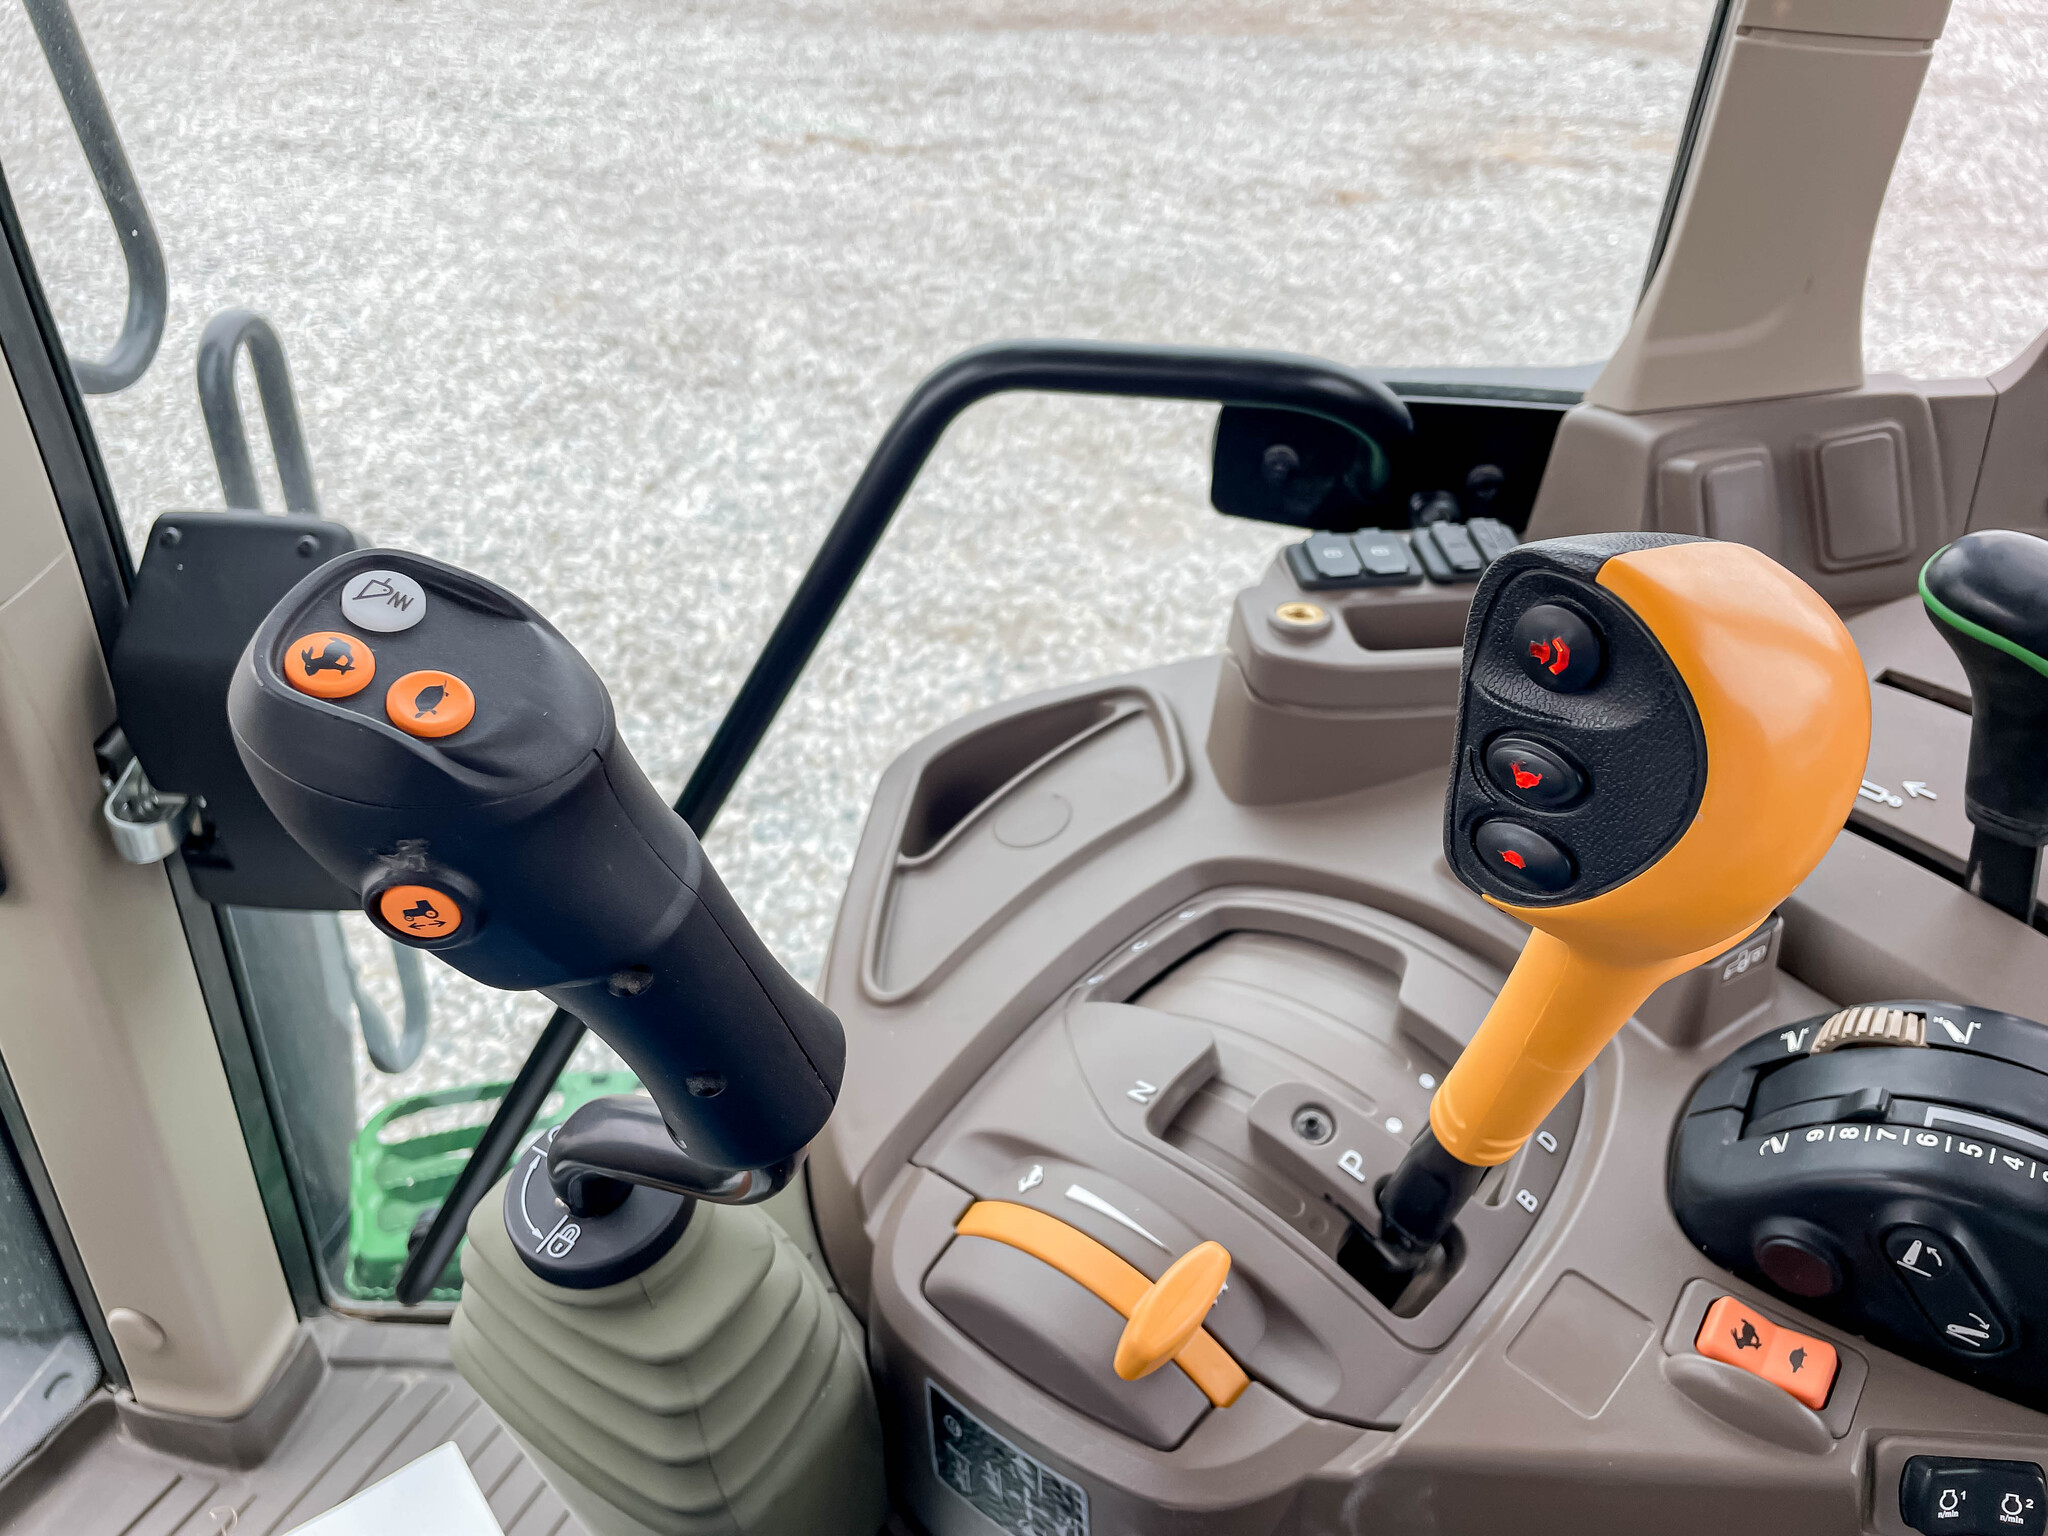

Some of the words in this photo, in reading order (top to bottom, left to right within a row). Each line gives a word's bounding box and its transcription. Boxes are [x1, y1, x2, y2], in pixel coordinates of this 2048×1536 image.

[1127, 1080, 1157, 1104] N
[1536, 1130, 1558, 1153] D
[1806, 1128, 1825, 1142] 9
[1839, 1127, 1860, 1140] 8
[1876, 1127, 1897, 1141] 7
[1916, 1133, 1939, 1147] 6
[1958, 1141, 1984, 1158] 5
[2002, 1155, 2025, 1171] 4
[1337, 1149, 1366, 1183] P
[1515, 1188, 1539, 1213] B
[1960, 1490, 1967, 1501] 1
[2025, 1498, 2035, 1509] 2
[1937, 1510, 1960, 1519] n/min
[1999, 1514, 2025, 1525] n/min
